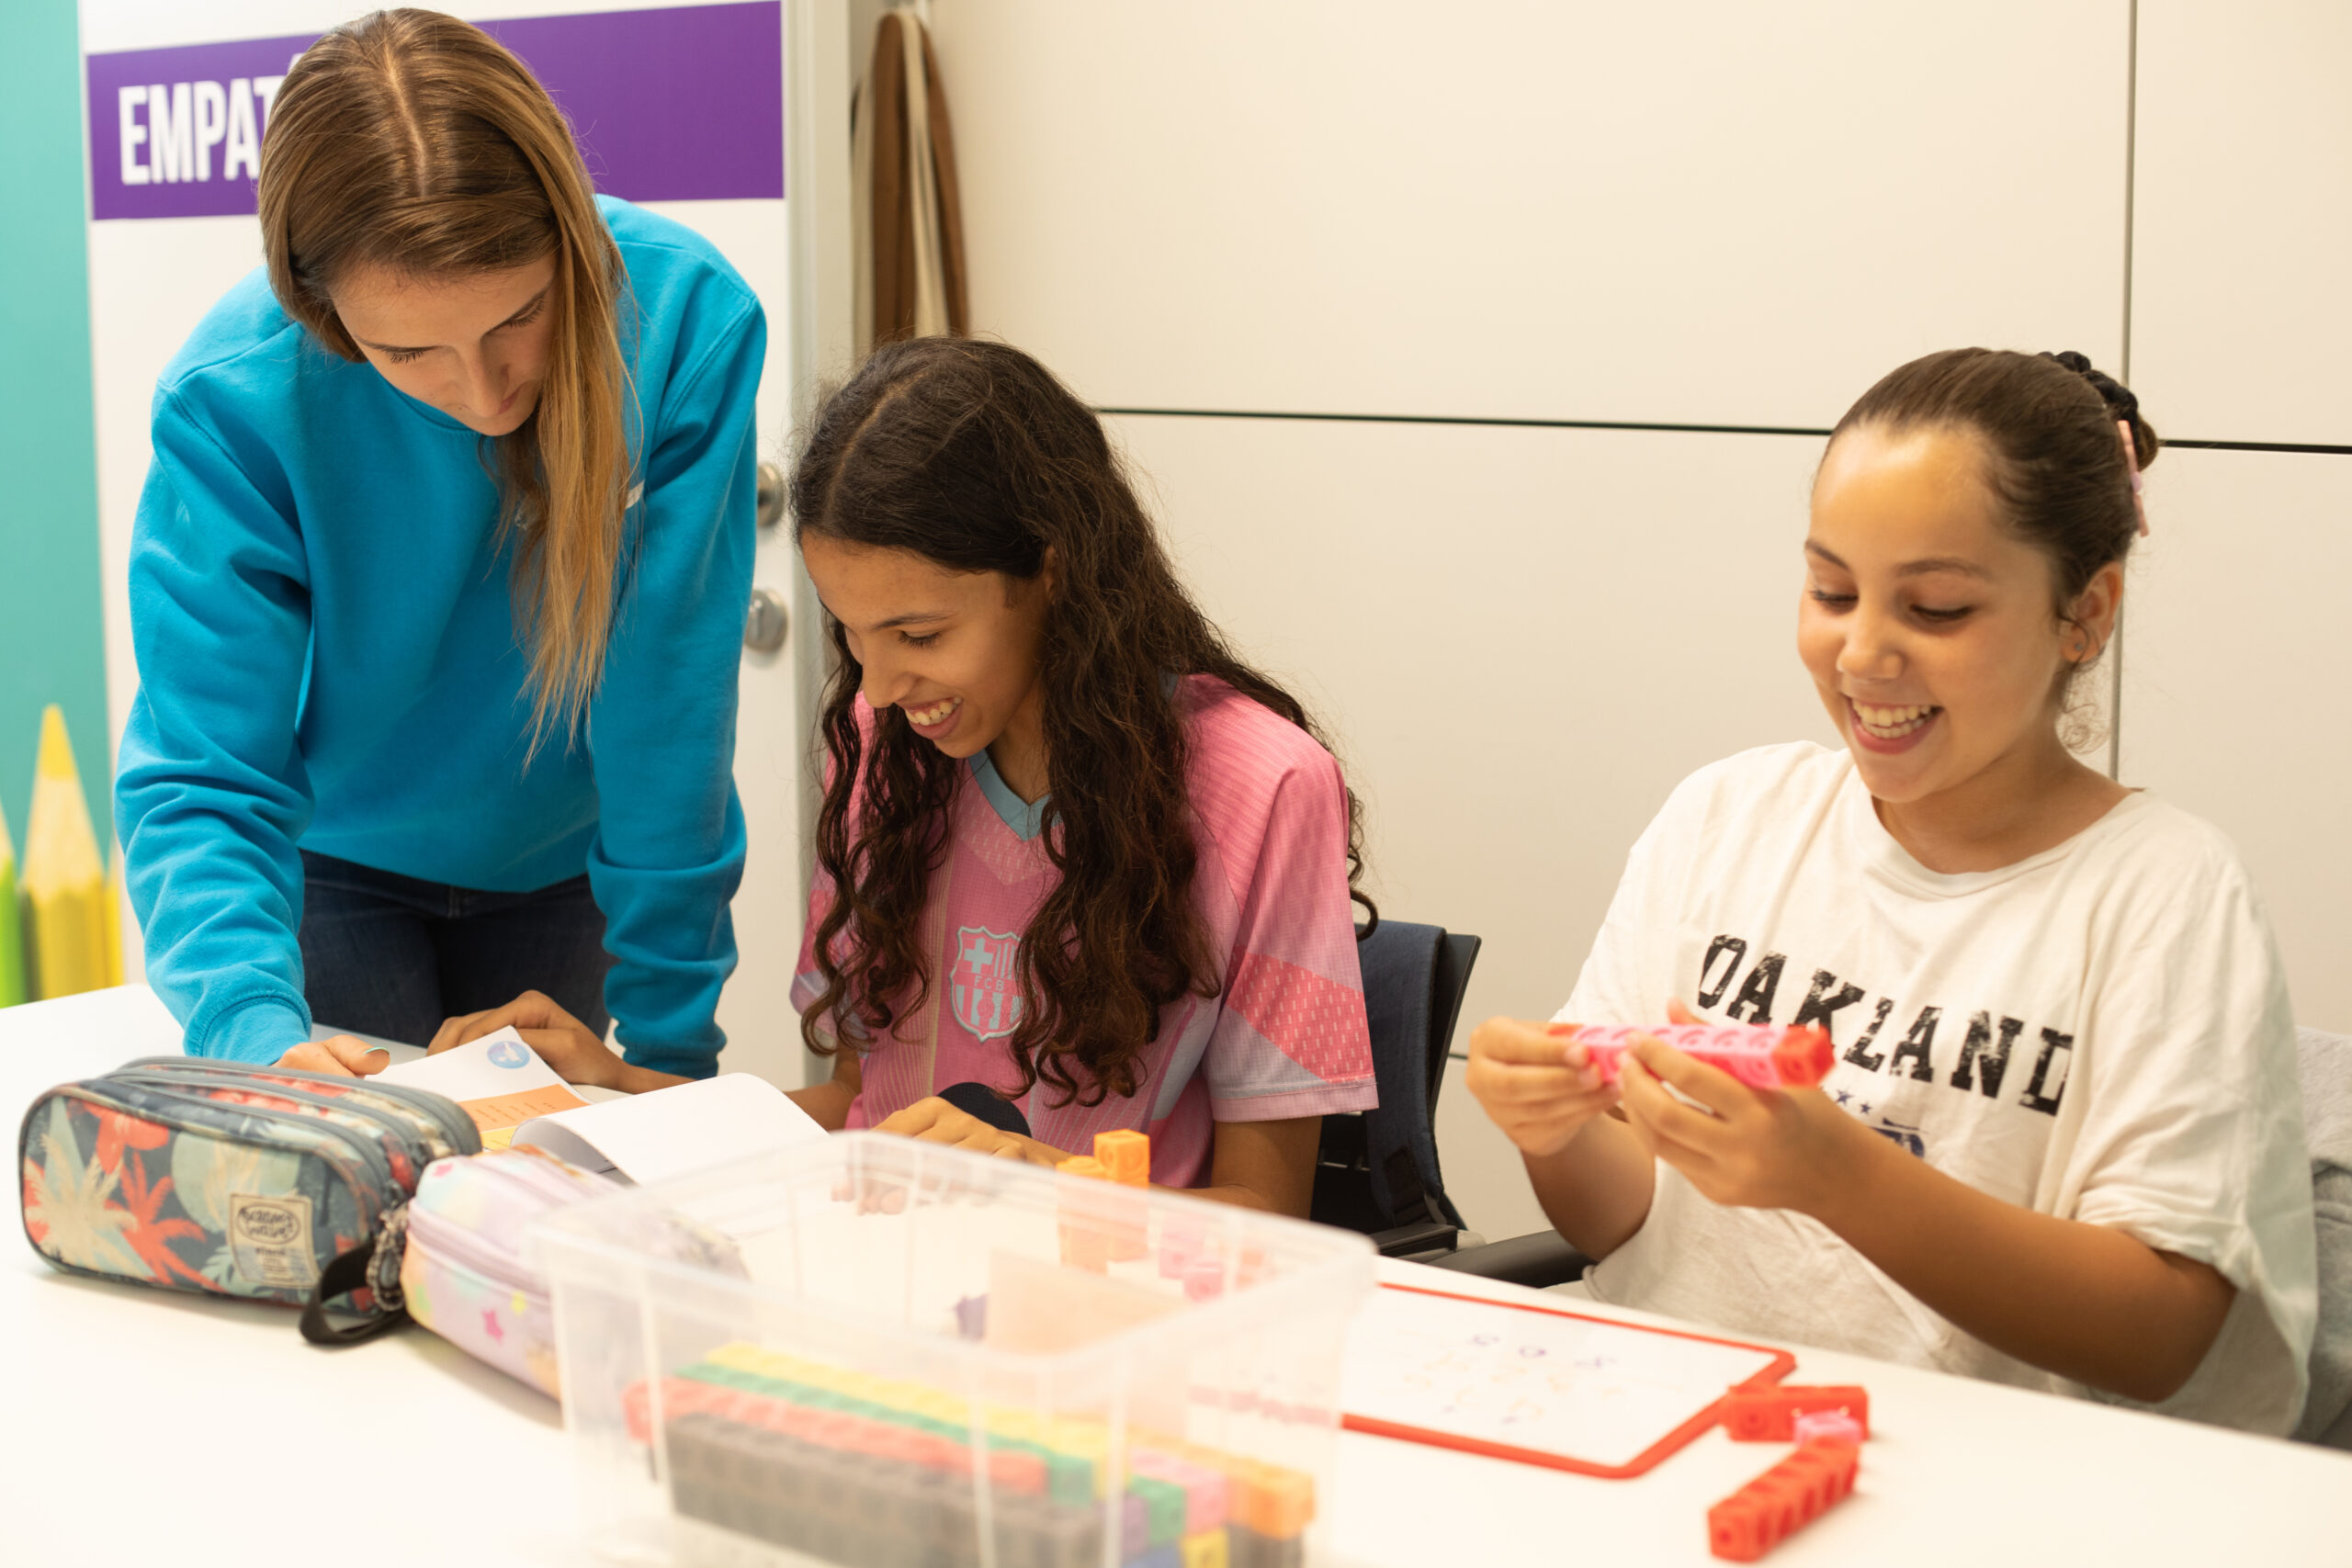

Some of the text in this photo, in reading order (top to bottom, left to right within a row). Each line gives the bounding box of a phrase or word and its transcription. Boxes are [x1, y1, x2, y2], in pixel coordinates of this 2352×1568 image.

[119, 53, 307, 186] EMPAT
[974, 975, 1005, 991] FCB
[1698, 934, 2074, 1116] OAKLAND
